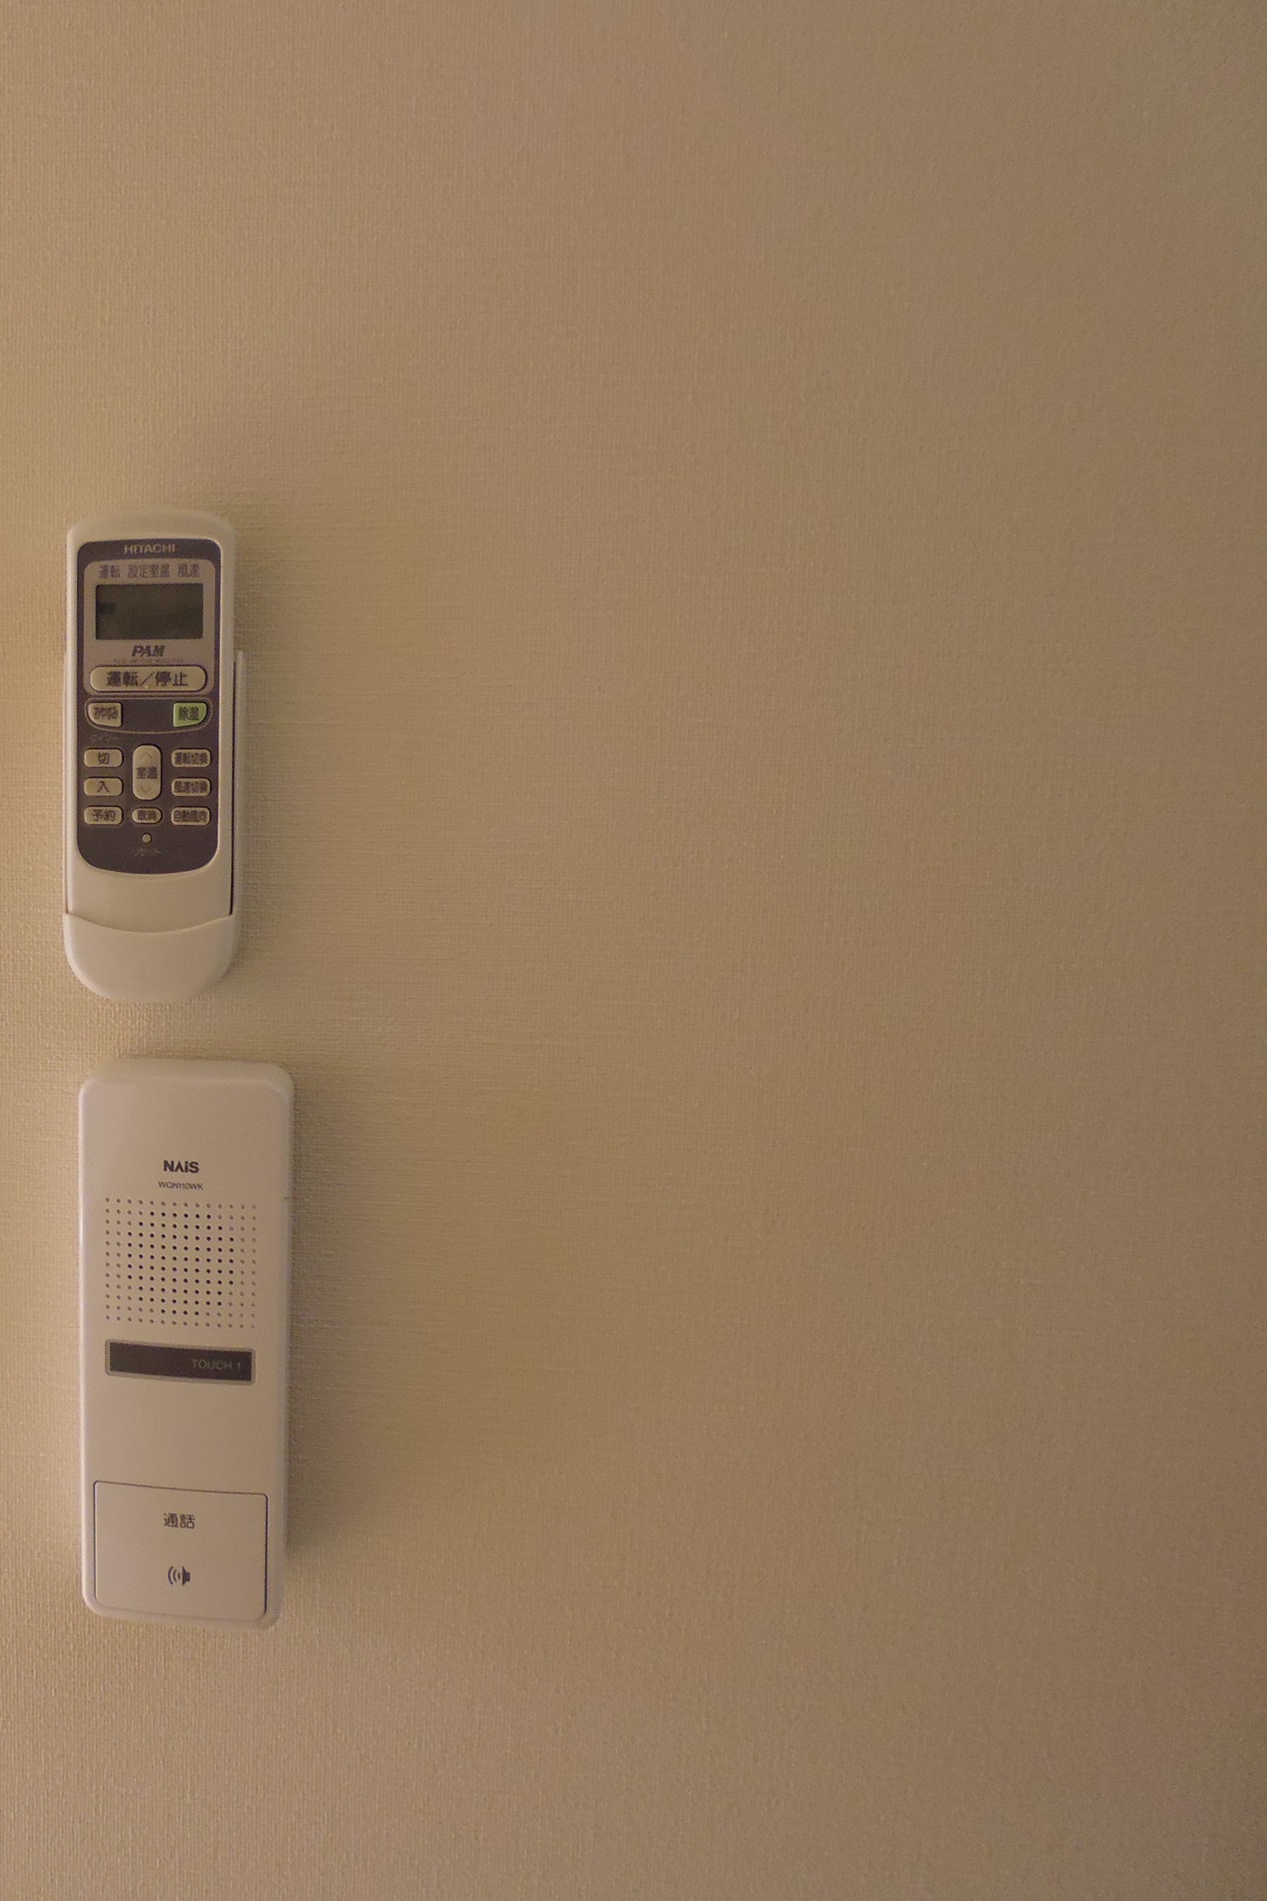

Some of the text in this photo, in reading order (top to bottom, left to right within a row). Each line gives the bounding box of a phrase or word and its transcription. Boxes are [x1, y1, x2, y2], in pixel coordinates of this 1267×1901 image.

[124, 543, 176, 554] HITACHI
[131, 644, 165, 656] PAM
[97, 752, 110, 765] 切
[96, 781, 110, 793] 入
[92, 809, 116, 822] 予約
[191, 1358, 233, 1371] TOUCH
[163, 1512, 196, 1530] 通話
